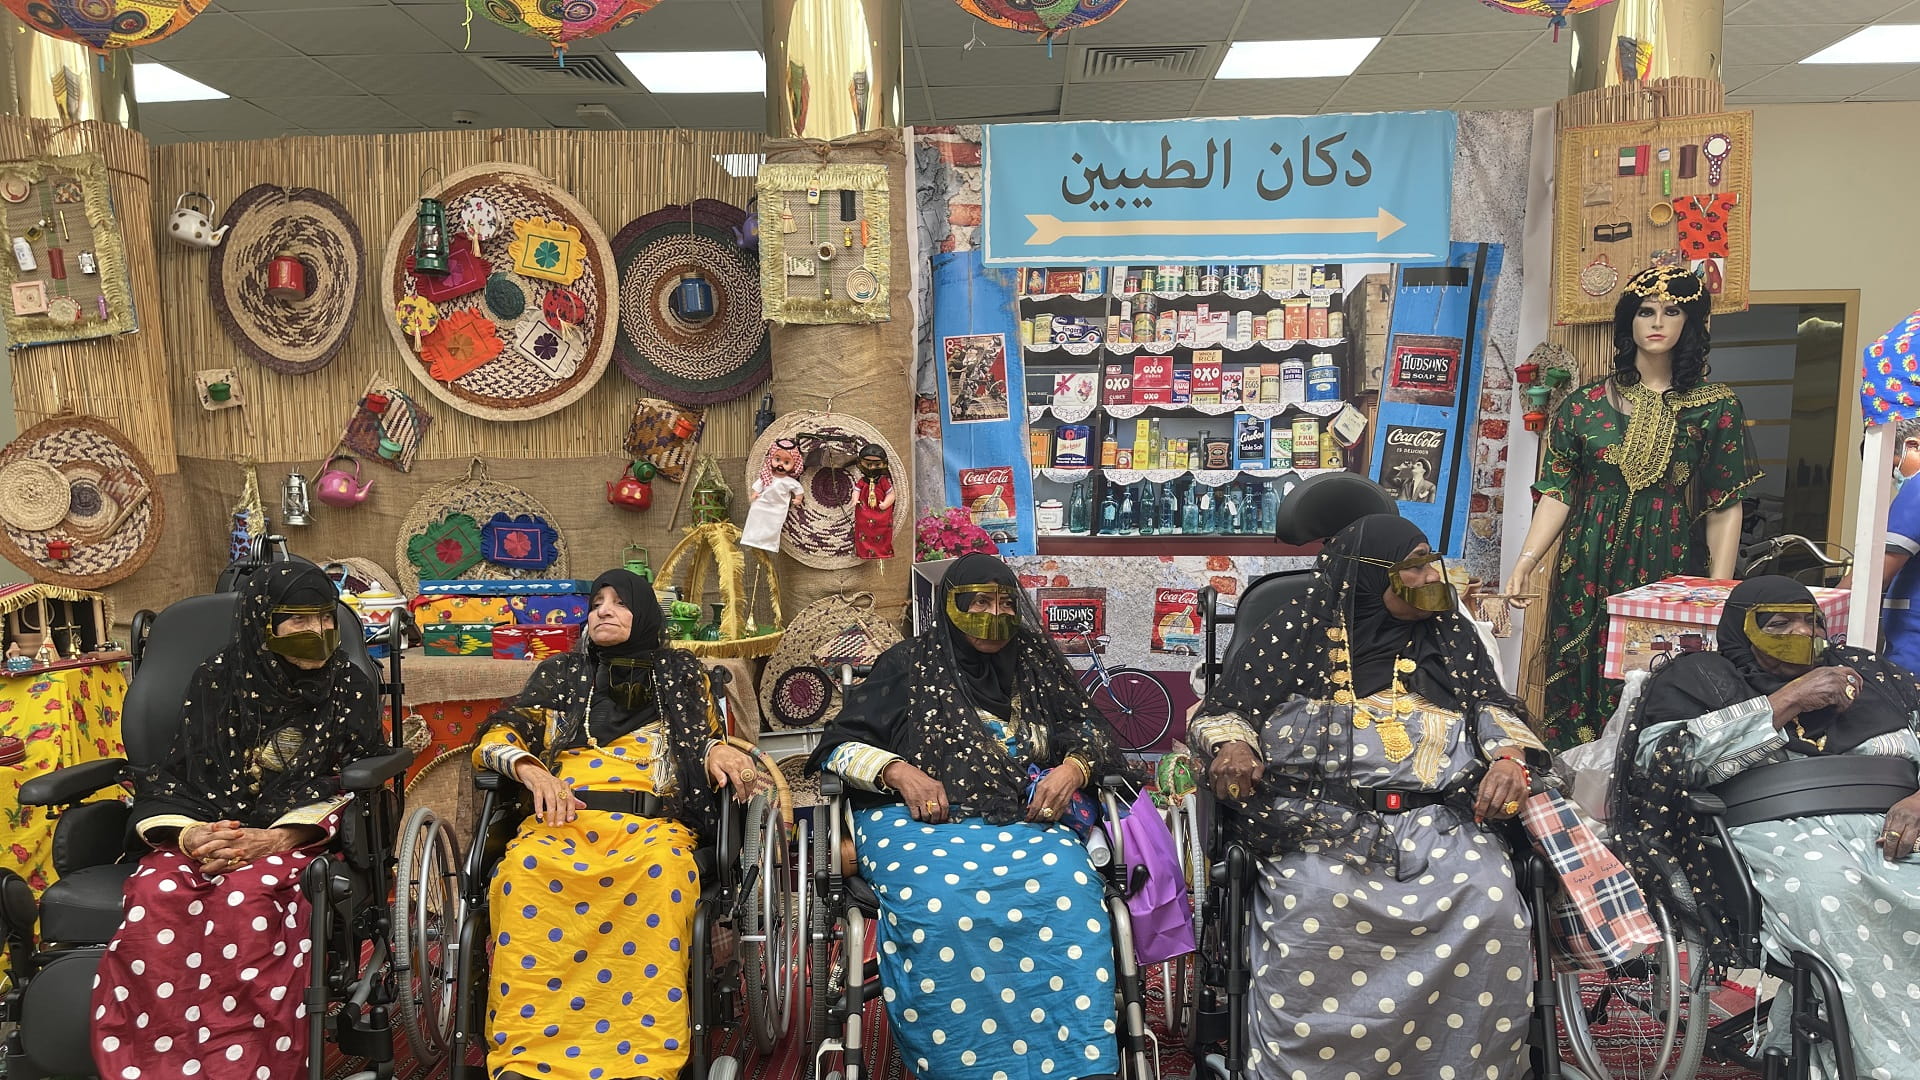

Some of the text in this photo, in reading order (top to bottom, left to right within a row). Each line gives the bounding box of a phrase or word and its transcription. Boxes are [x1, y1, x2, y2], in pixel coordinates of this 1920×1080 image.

[1062, 131, 1372, 212] دكان الطيبين
[1143, 365, 1164, 374] OXO
[1401, 353, 1449, 372] HUDSON'S
[1193, 367, 1220, 381] OXO
[1223, 374, 1241, 382] OXO
[1105, 377, 1130, 391] OXO
[1244, 380, 1259, 389] EGGS
[1049, 606, 1094, 622] HUDSON'S
